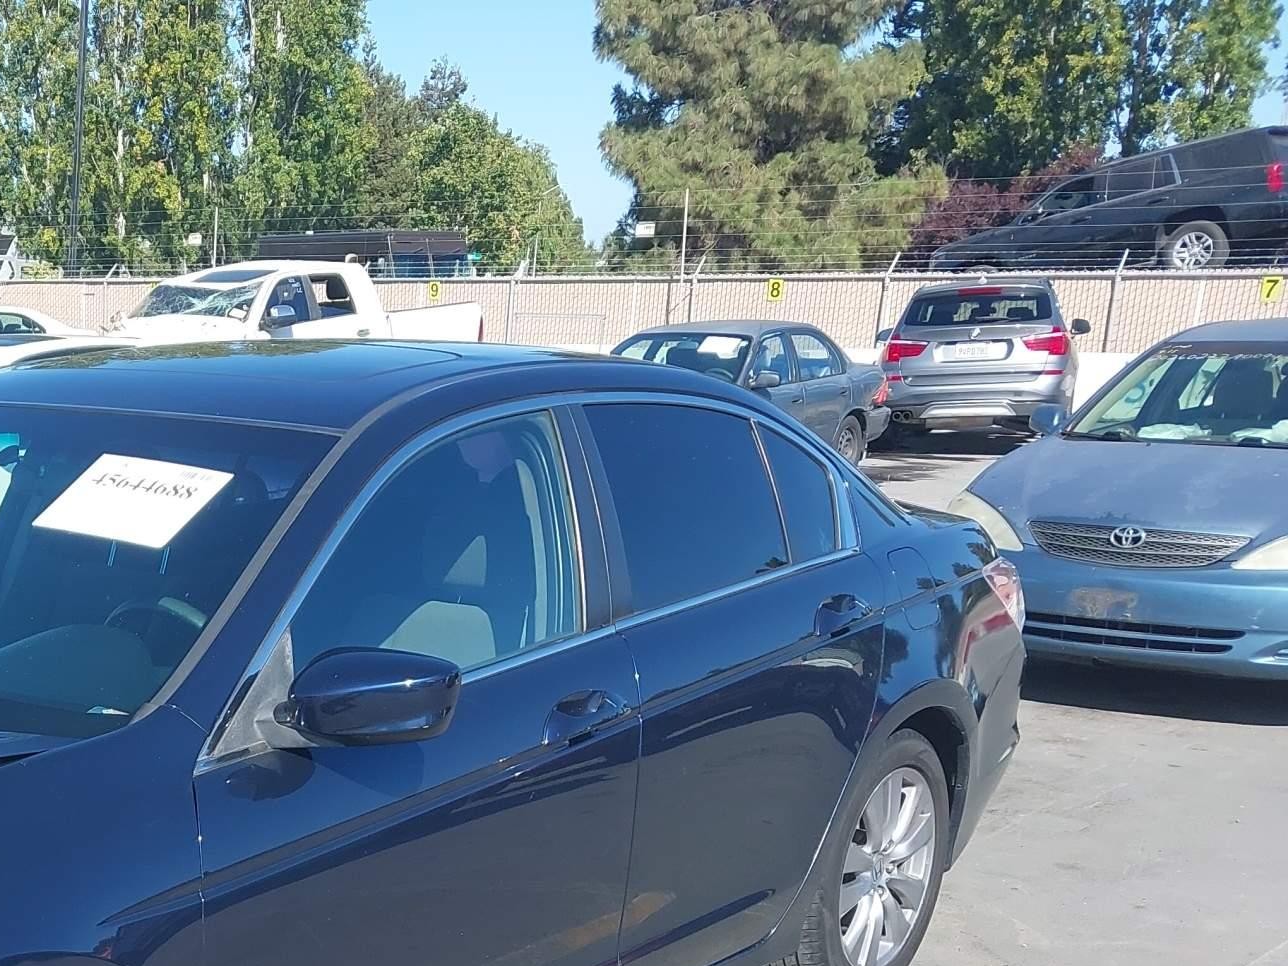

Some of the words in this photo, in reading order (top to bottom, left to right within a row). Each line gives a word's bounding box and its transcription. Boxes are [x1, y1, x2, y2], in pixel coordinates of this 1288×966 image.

[430, 283, 439, 297] 9
[770, 281, 781, 298] 8
[1265, 279, 1280, 299] 7
